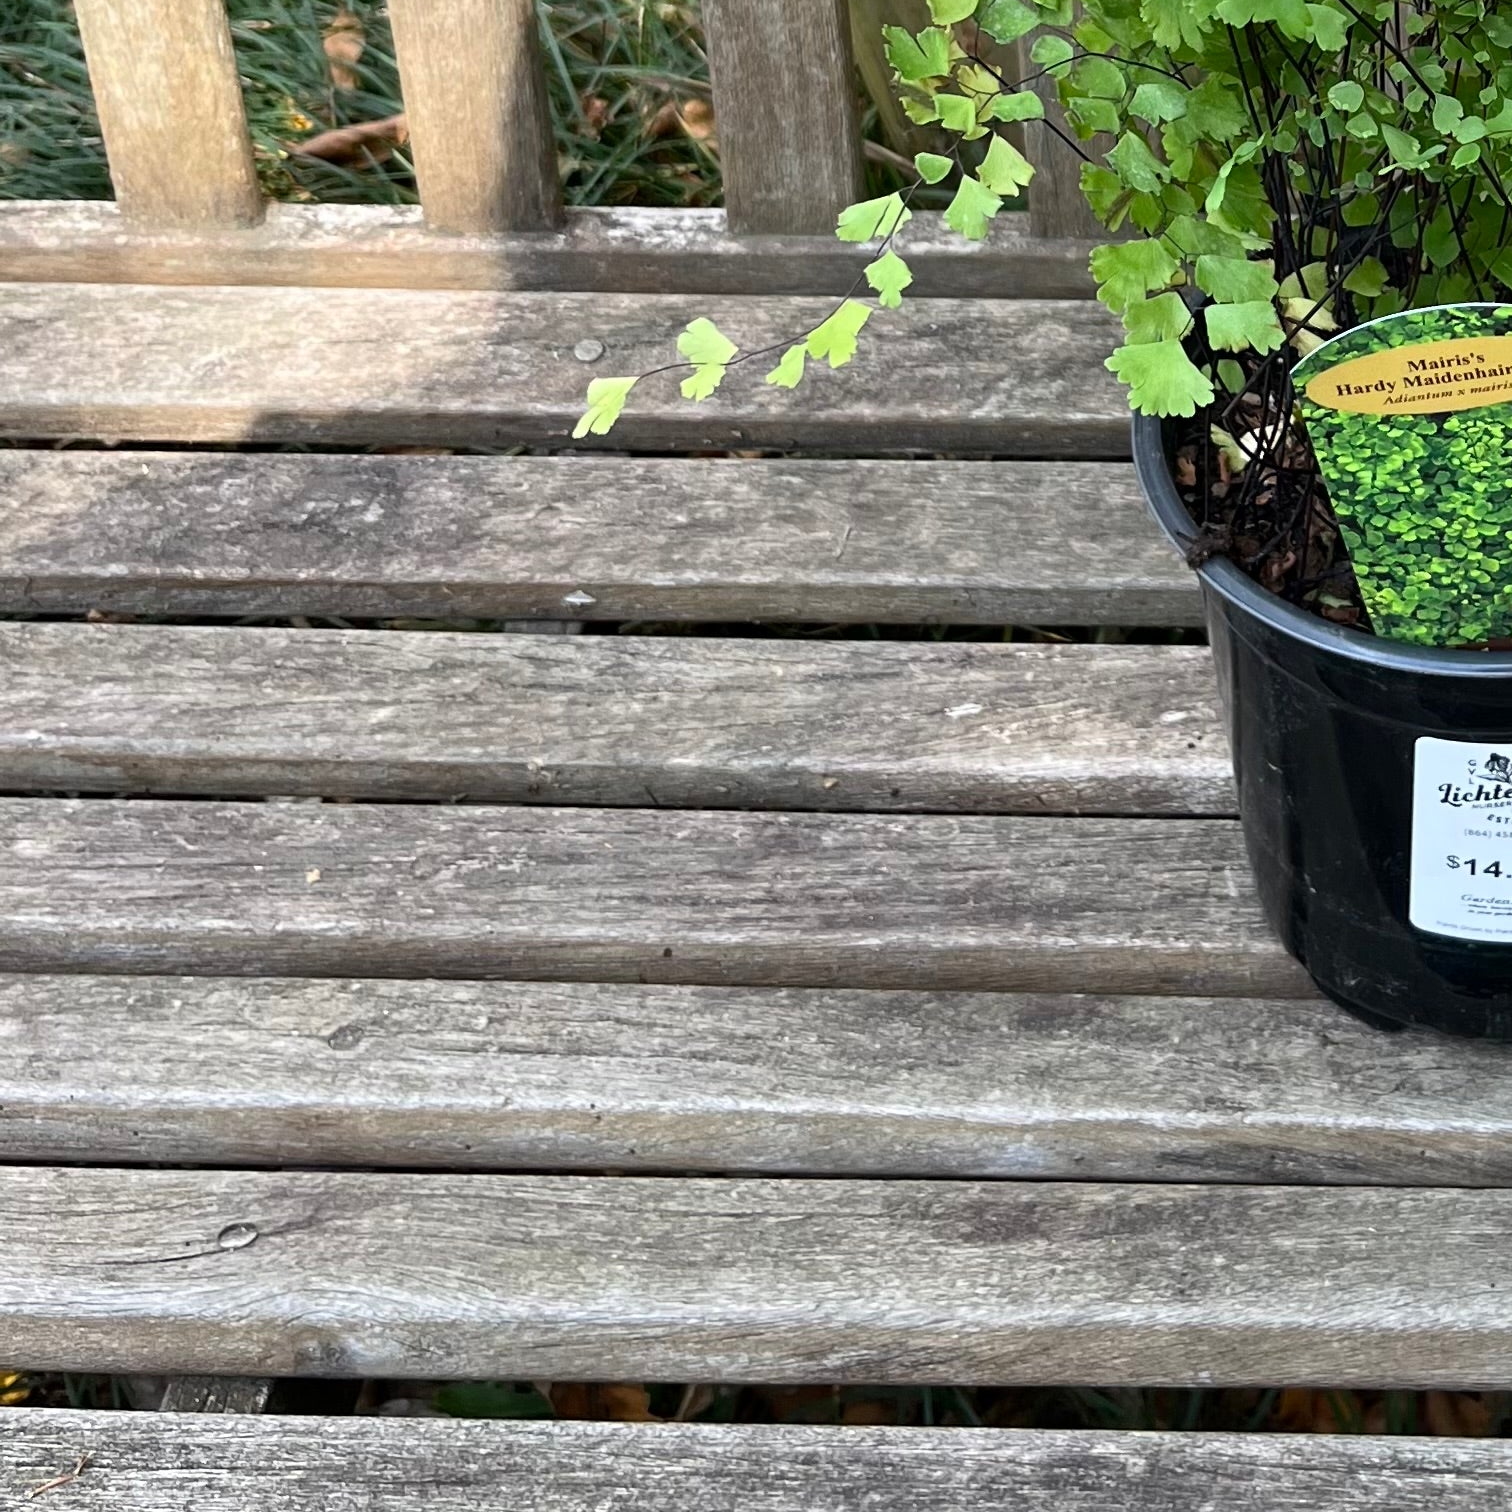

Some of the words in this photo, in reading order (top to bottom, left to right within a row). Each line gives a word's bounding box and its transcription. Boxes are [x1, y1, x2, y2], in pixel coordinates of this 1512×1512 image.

[1407, 352, 1486, 373] Mairis's
[1335, 379, 1397, 397] Hardy
[1382, 389, 1454, 406] Adiantum
